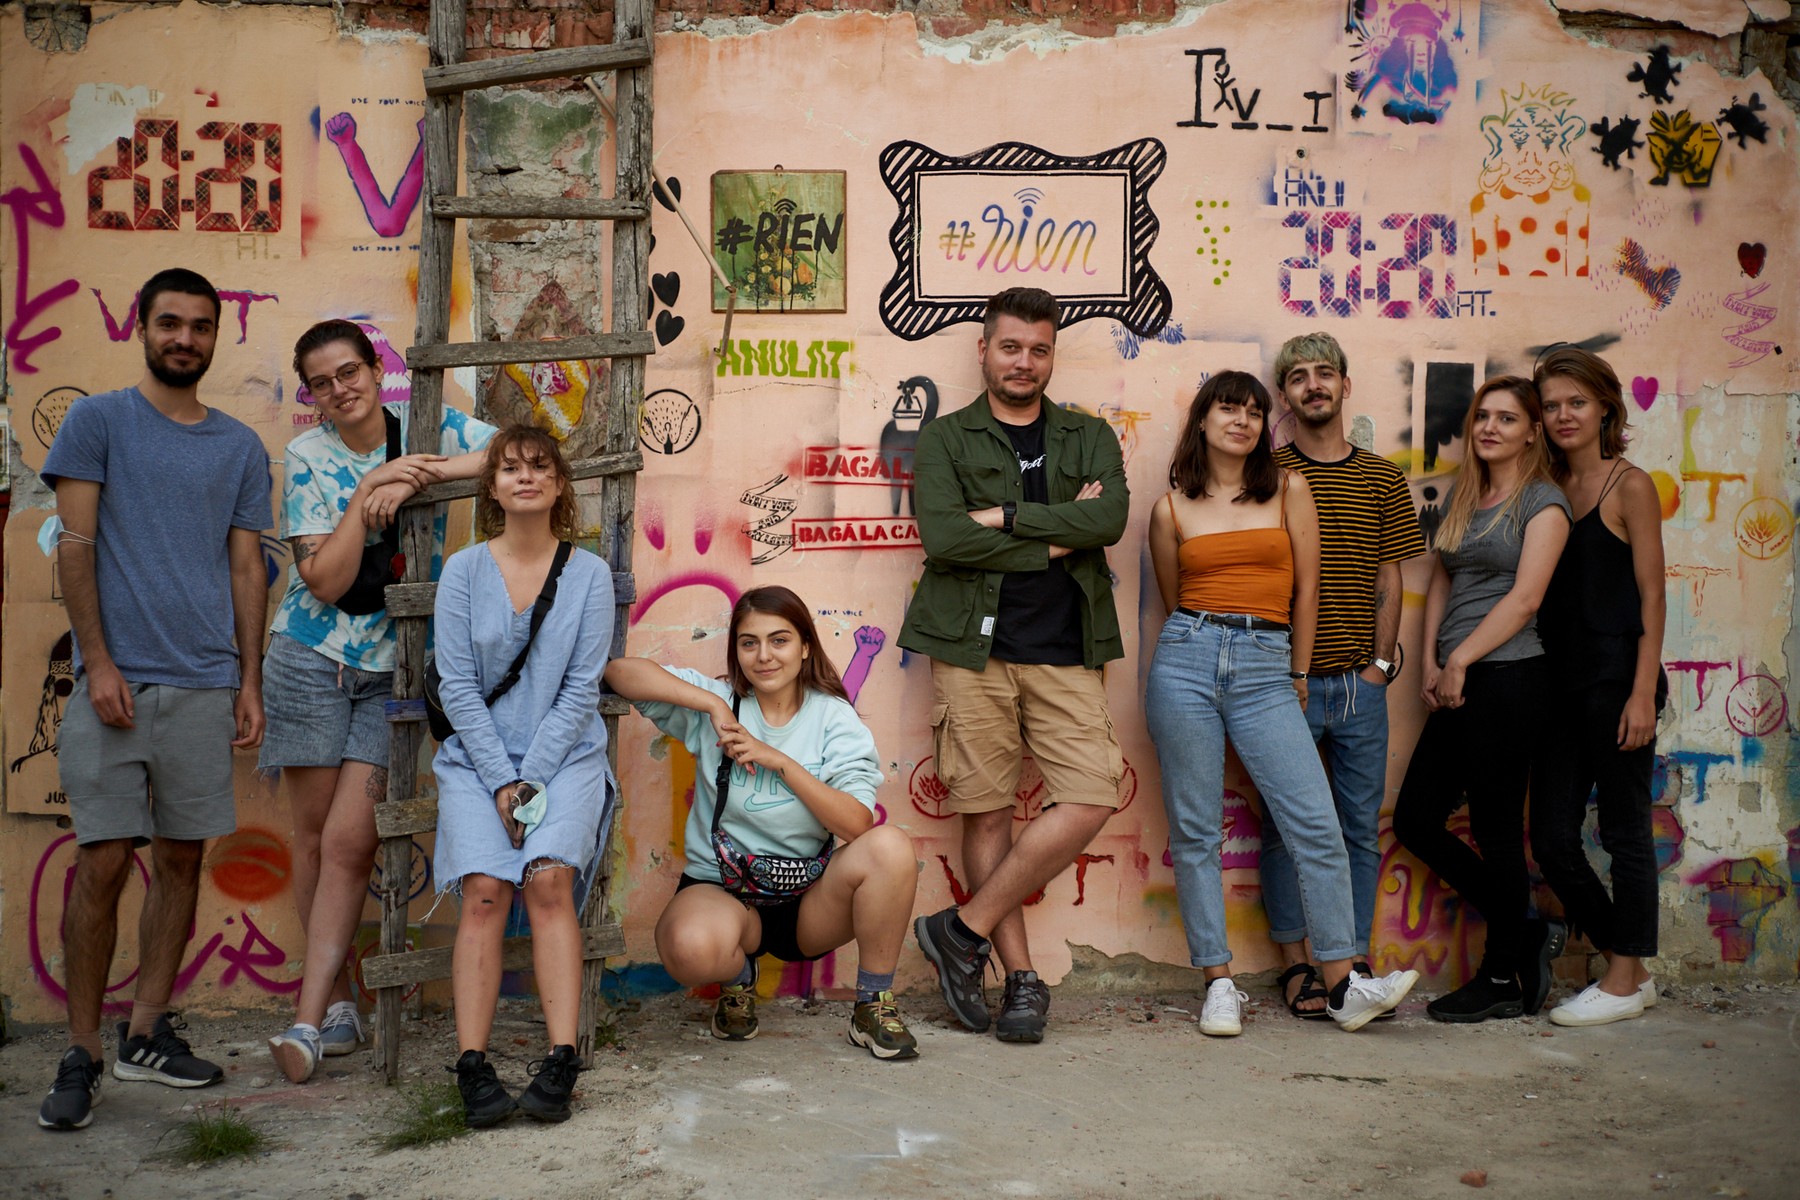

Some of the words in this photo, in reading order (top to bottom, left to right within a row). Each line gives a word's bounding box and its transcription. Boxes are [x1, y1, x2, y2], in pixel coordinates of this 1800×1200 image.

[87, 118, 282, 233] 20:20
[714, 212, 845, 254] #RIEN
[939, 203, 1098, 275] #rien
[1277, 210, 1458, 319] 20:20
[716, 339, 849, 379] ANULAT
[860, 525, 888, 541] LA
[891, 525, 919, 540] CA
[44, 791, 67, 804] JUS
